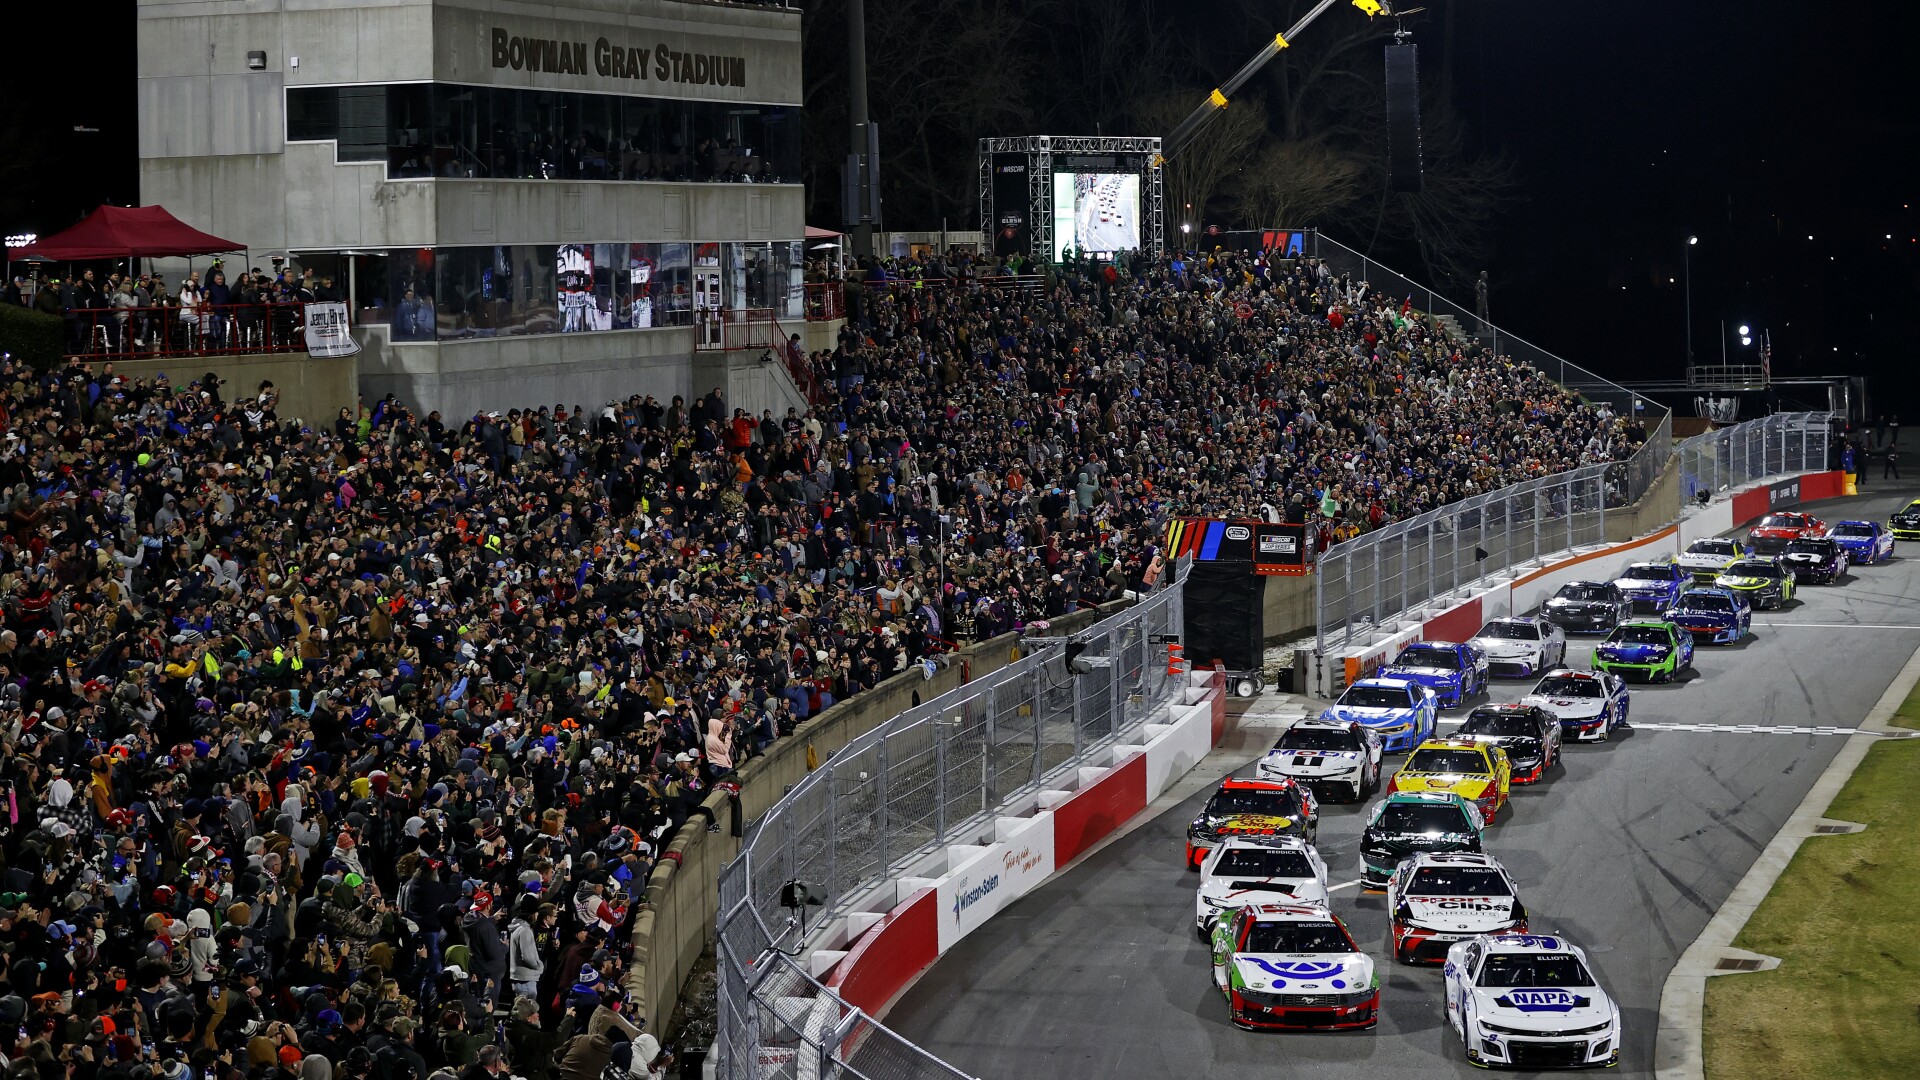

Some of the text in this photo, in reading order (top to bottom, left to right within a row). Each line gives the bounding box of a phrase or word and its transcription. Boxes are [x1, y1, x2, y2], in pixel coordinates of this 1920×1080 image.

[491, 27, 745, 87] BOWMAN GRAY STADIUM
[1003, 165, 1025, 173] NASCAR
[1236, 821, 1280, 829] Shops
[1217, 827, 1275, 835] CLUB
[1409, 896, 1492, 904] Sport
[1438, 902, 1511, 912] Clips
[1513, 992, 1575, 1004] NAPA
